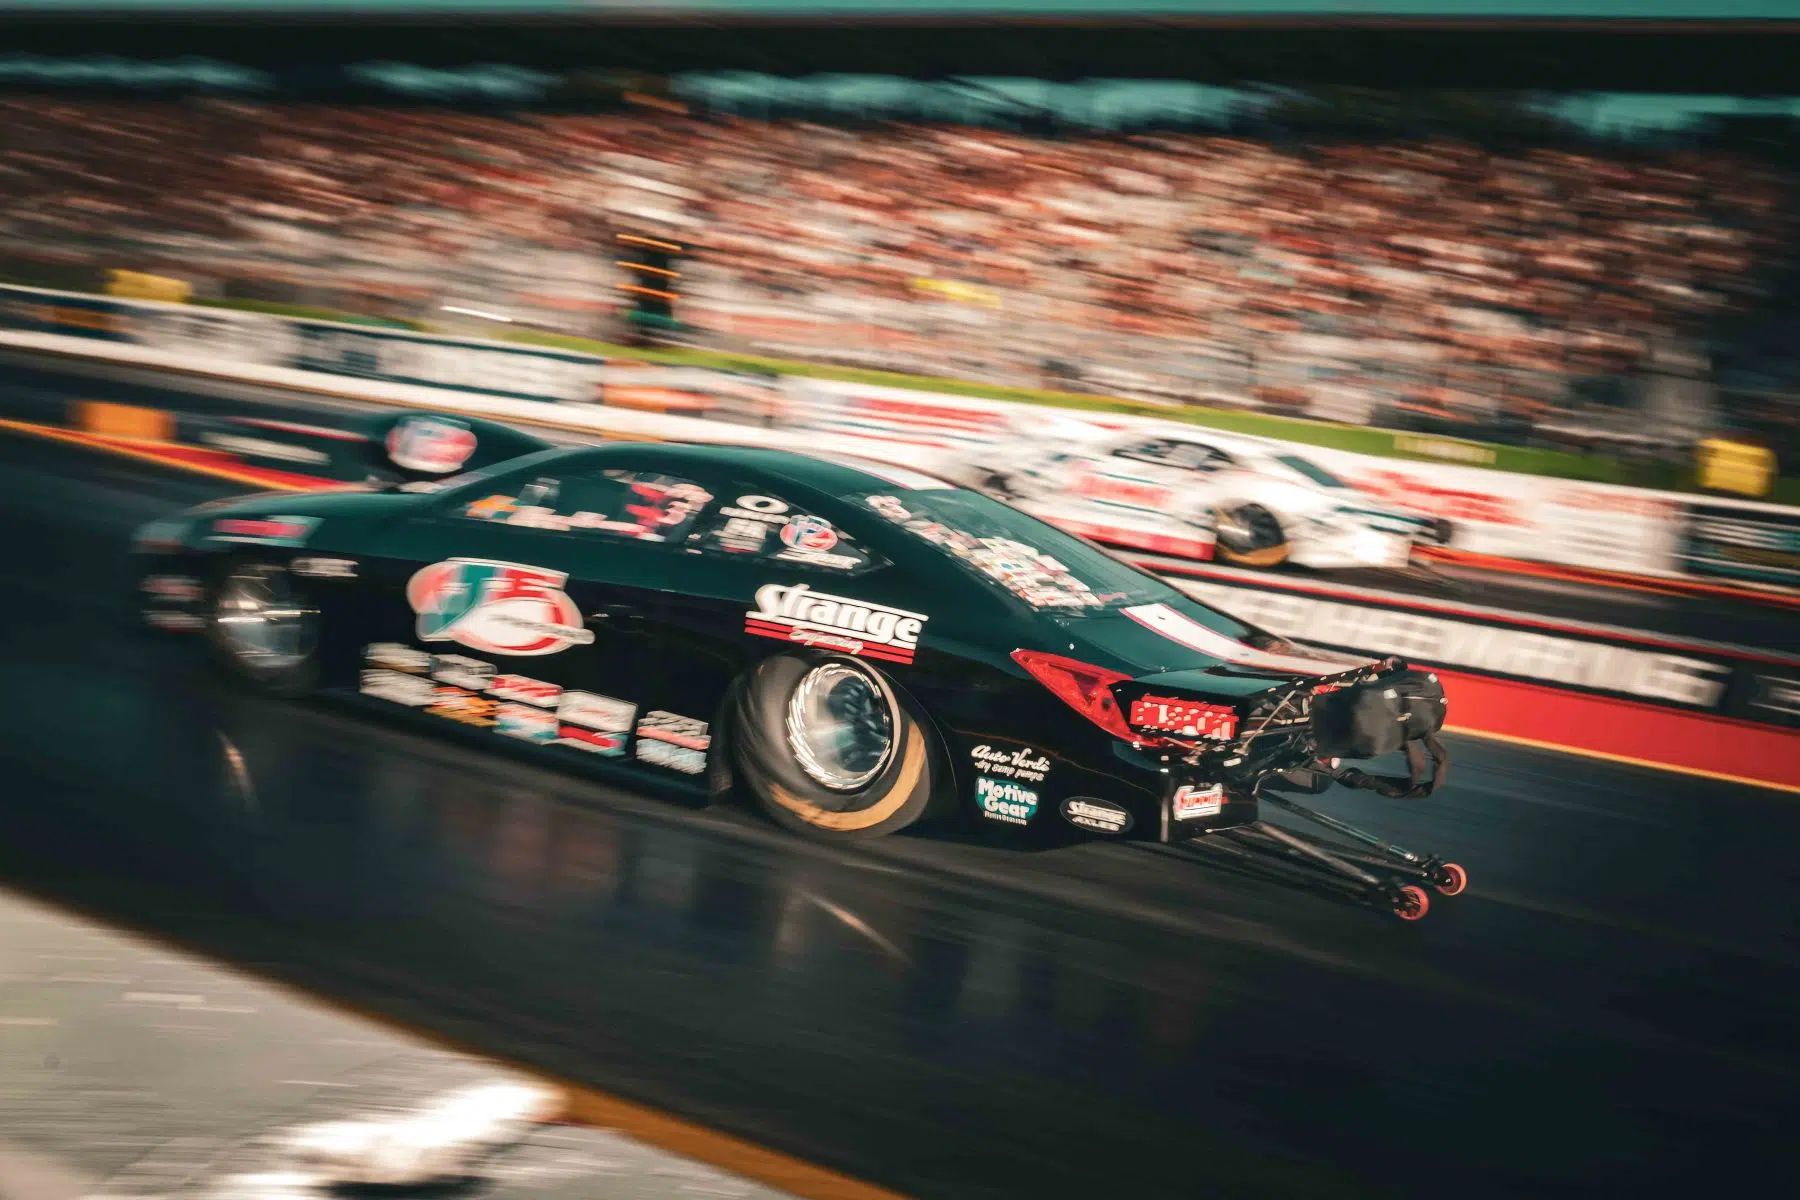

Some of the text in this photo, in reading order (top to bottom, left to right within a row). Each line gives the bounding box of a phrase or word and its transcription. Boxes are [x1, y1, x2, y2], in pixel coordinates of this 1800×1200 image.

[745, 583, 929, 649] Strange
[971, 744, 1050, 771] Auto Verdi
[978, 778, 1038, 805] Motive
[984, 795, 1028, 819] Gear
